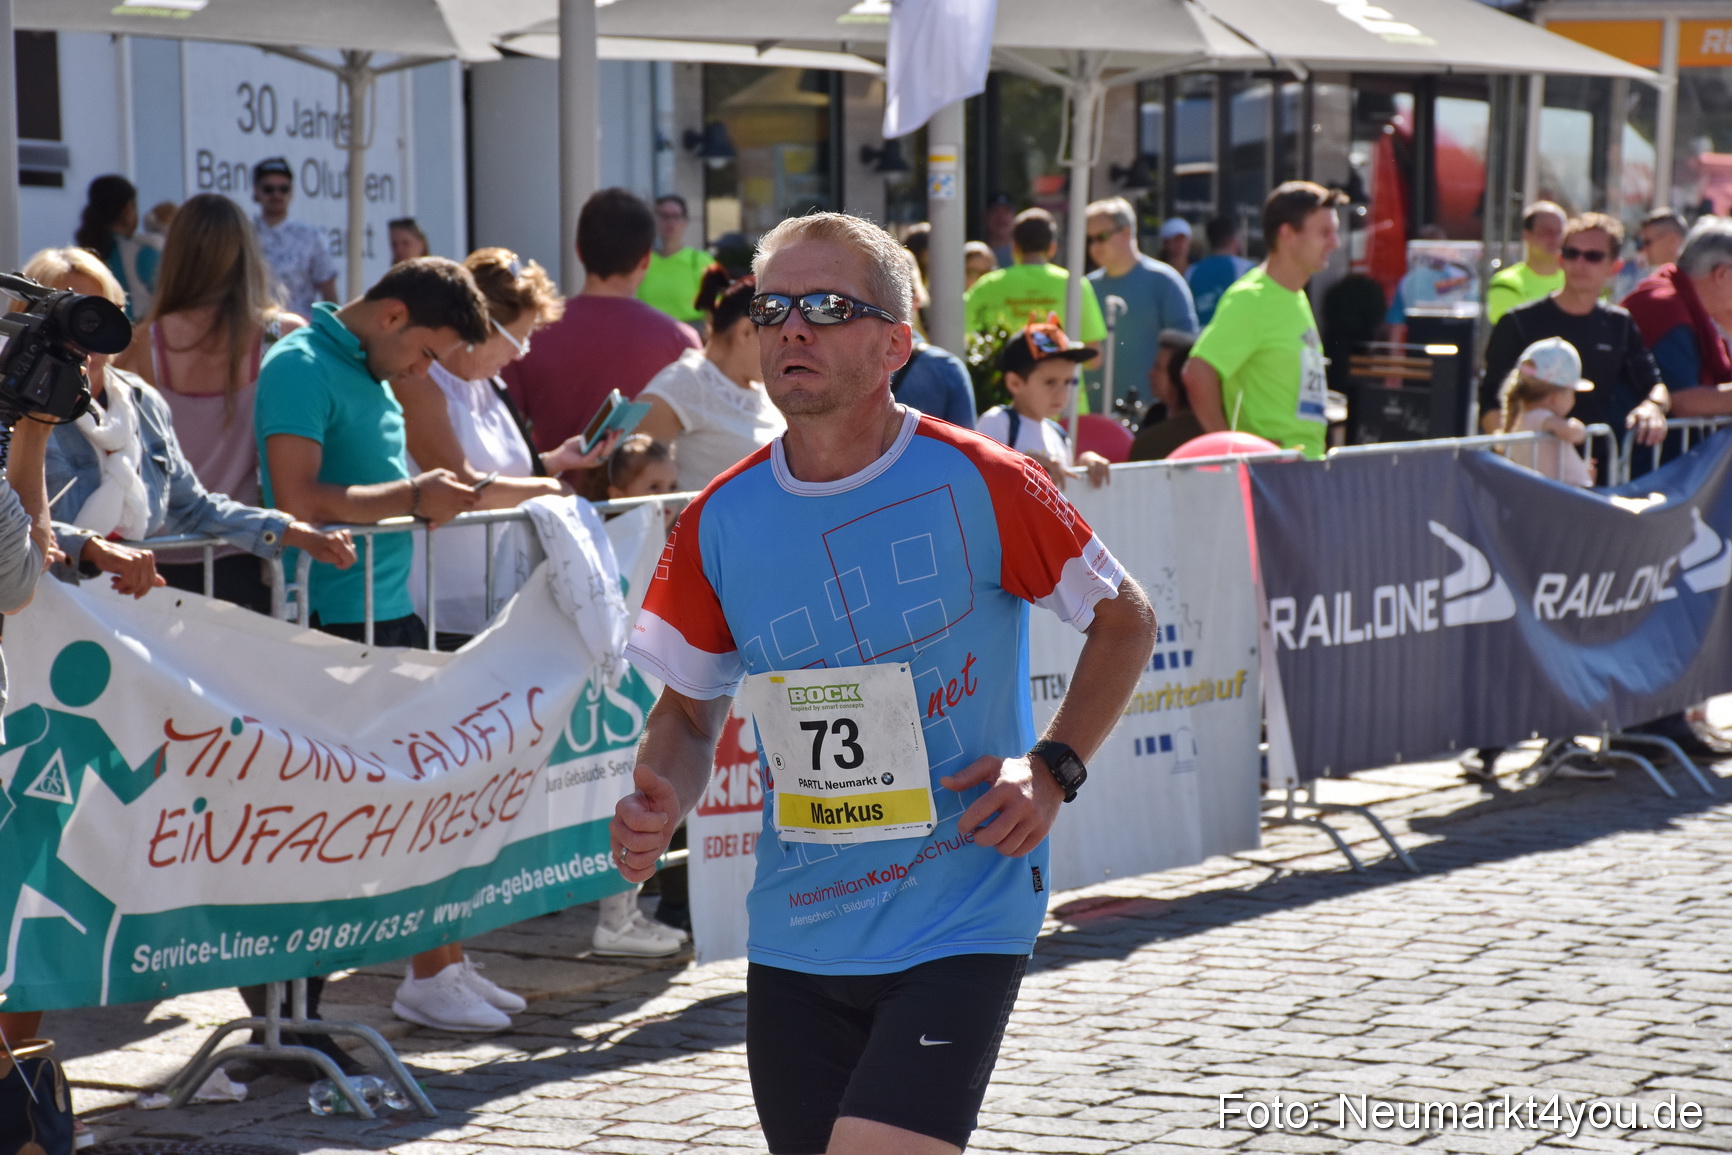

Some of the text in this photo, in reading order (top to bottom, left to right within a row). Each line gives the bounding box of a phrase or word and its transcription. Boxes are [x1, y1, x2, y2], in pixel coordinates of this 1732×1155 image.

[236, 82, 278, 135] 30
[196, 150, 255, 191] Ban
[1534, 556, 1678, 621] RAIL.ONE
[1270, 578, 1440, 650] RAIL.ONE
[788, 684, 863, 704] BOCK
[927, 651, 978, 718] net
[790, 704, 812, 712] inspired
[775, 757, 783, 767] B
[800, 718, 864, 770] 73
[798, 775, 878, 790] PARTL Neumarkt
[811, 802, 884, 825] Markus
[789, 908, 836, 927] Menschen
[842, 894, 876, 914] Bildung
[131, 935, 279, 974] Service-Line:
